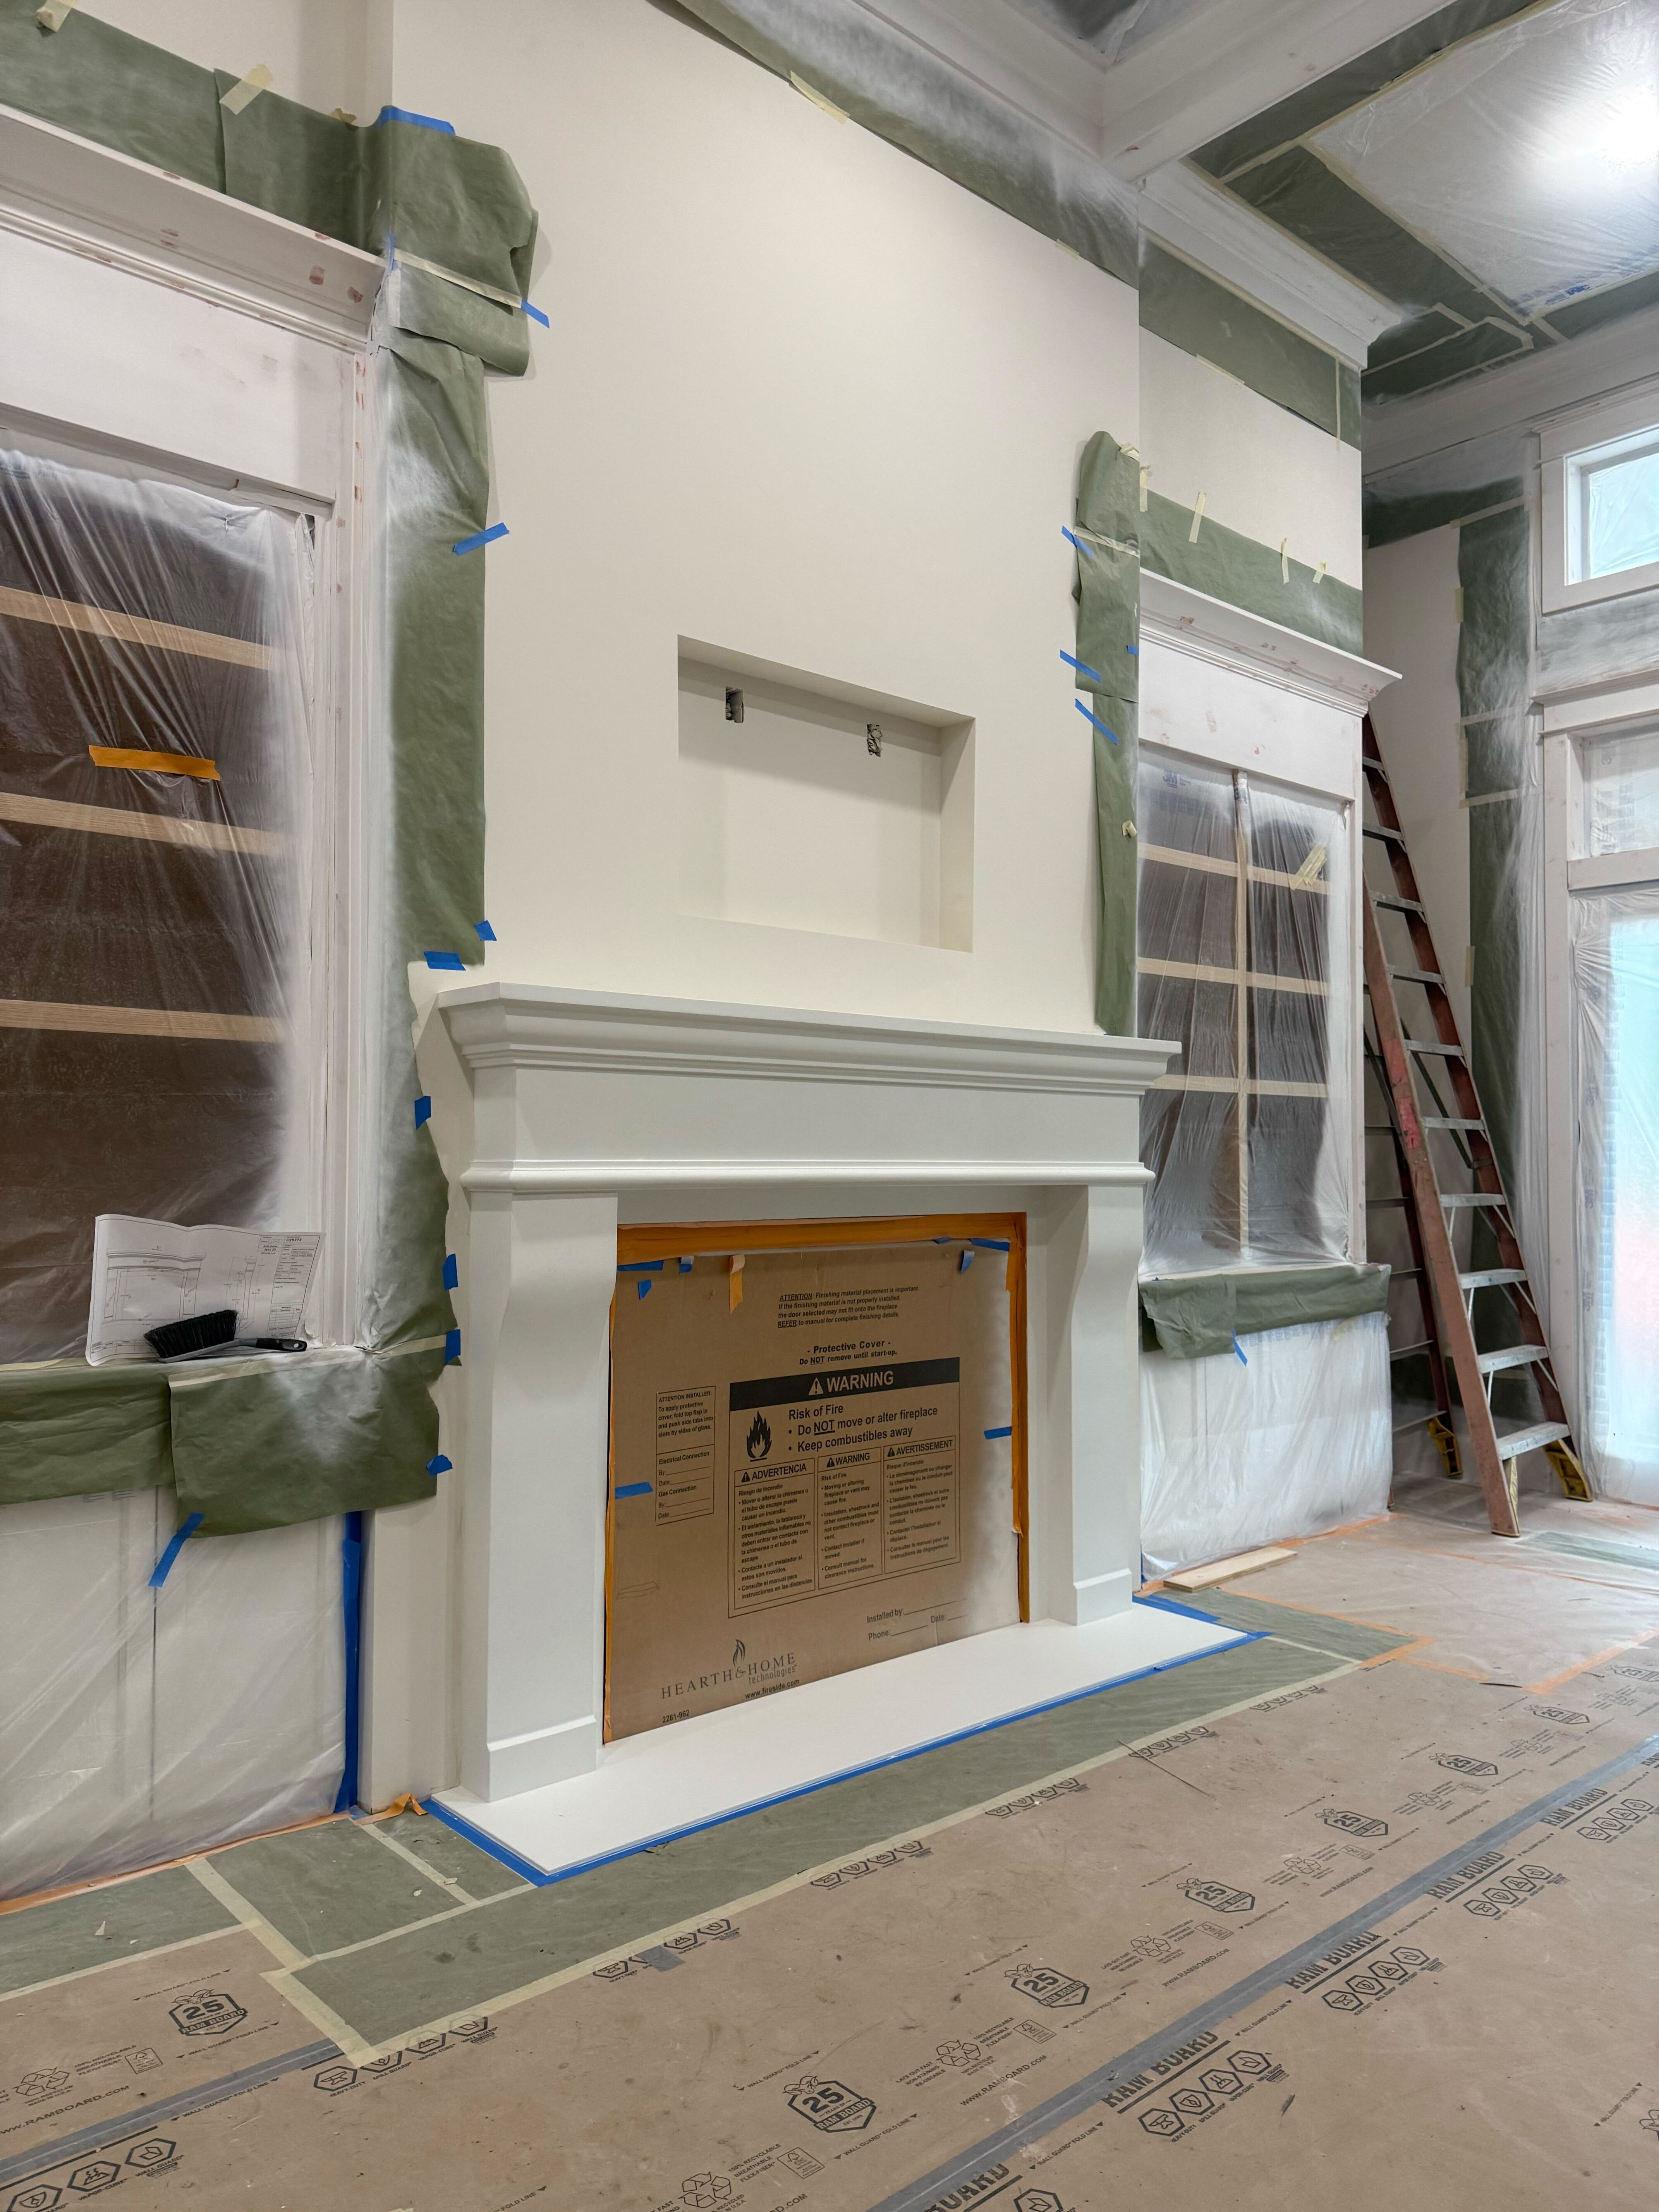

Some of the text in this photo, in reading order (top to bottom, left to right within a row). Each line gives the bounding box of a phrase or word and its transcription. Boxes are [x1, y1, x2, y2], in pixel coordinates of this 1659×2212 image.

[779, 1293, 813, 1302] ATTENTION:
[777, 1319, 797, 1328] REFER
[813, 1343, 856, 1353] Protective
[810, 1356, 825, 1365] NOT
[827, 1371, 894, 1392] WARNING
[659, 1394, 684, 1402] ATTENTION
[679, 1401, 703, 1410] protective
[789, 1404, 843, 1420] Risk of Fire
[798, 1425, 811, 1436] Do
[814, 1419, 835, 1436] NOT
[837, 1418, 862, 1429] move
[865, 1416, 875, 1424] or
[878, 1412, 897, 1422] alter
[798, 1427, 912, 1452] Keep combustibles away
[896, 1439, 952, 1455] AVERTISSEMENT
[658, 1451, 709, 1464] Electrical Connection
[835, 1452, 870, 1465] WARNING
[752, 1463, 806, 1480] ADVERTENCIA
[669, 1486, 696, 1494] Connection
[867, 1609, 904, 1623] Installed by:
[868, 1630, 890, 1640] Phone:
[745, 1680, 800, 1700] www.fireside.com
[662, 1710, 690, 1723] 2281-962
[1447, 1758, 1472, 1768] 25
[1333, 1814, 1361, 1827] 25
[1195, 1886, 1227, 1901] 25
[1423, 1877, 1465, 1899] RAM
[1024, 1973, 1059, 1993] 25
[1040, 1982, 1084, 2006] RAM BOARD
[182, 1999, 225, 2020] 25
[181, 2009, 245, 2033] RAM BOARD
[905, 2065, 940, 2086] NON-STAINING
[960, 2055, 1047, 2106] WWW.RAMBOARD.COM
[182, 2108, 204, 2117] WALL
[233, 2088, 253, 2097] FOLD
[253, 2082, 270, 2090] LINE
[802, 2087, 844, 2113] 25
[816, 2099, 871, 2130] RAM BOARD
[1037, 2155, 1053, 2165] WALL
[1071, 2134, 1086, 2144] FOLD
[1084, 2126, 1098, 2135] LINE
[728, 2143, 781, 2172] 100% RECYCLABLE
